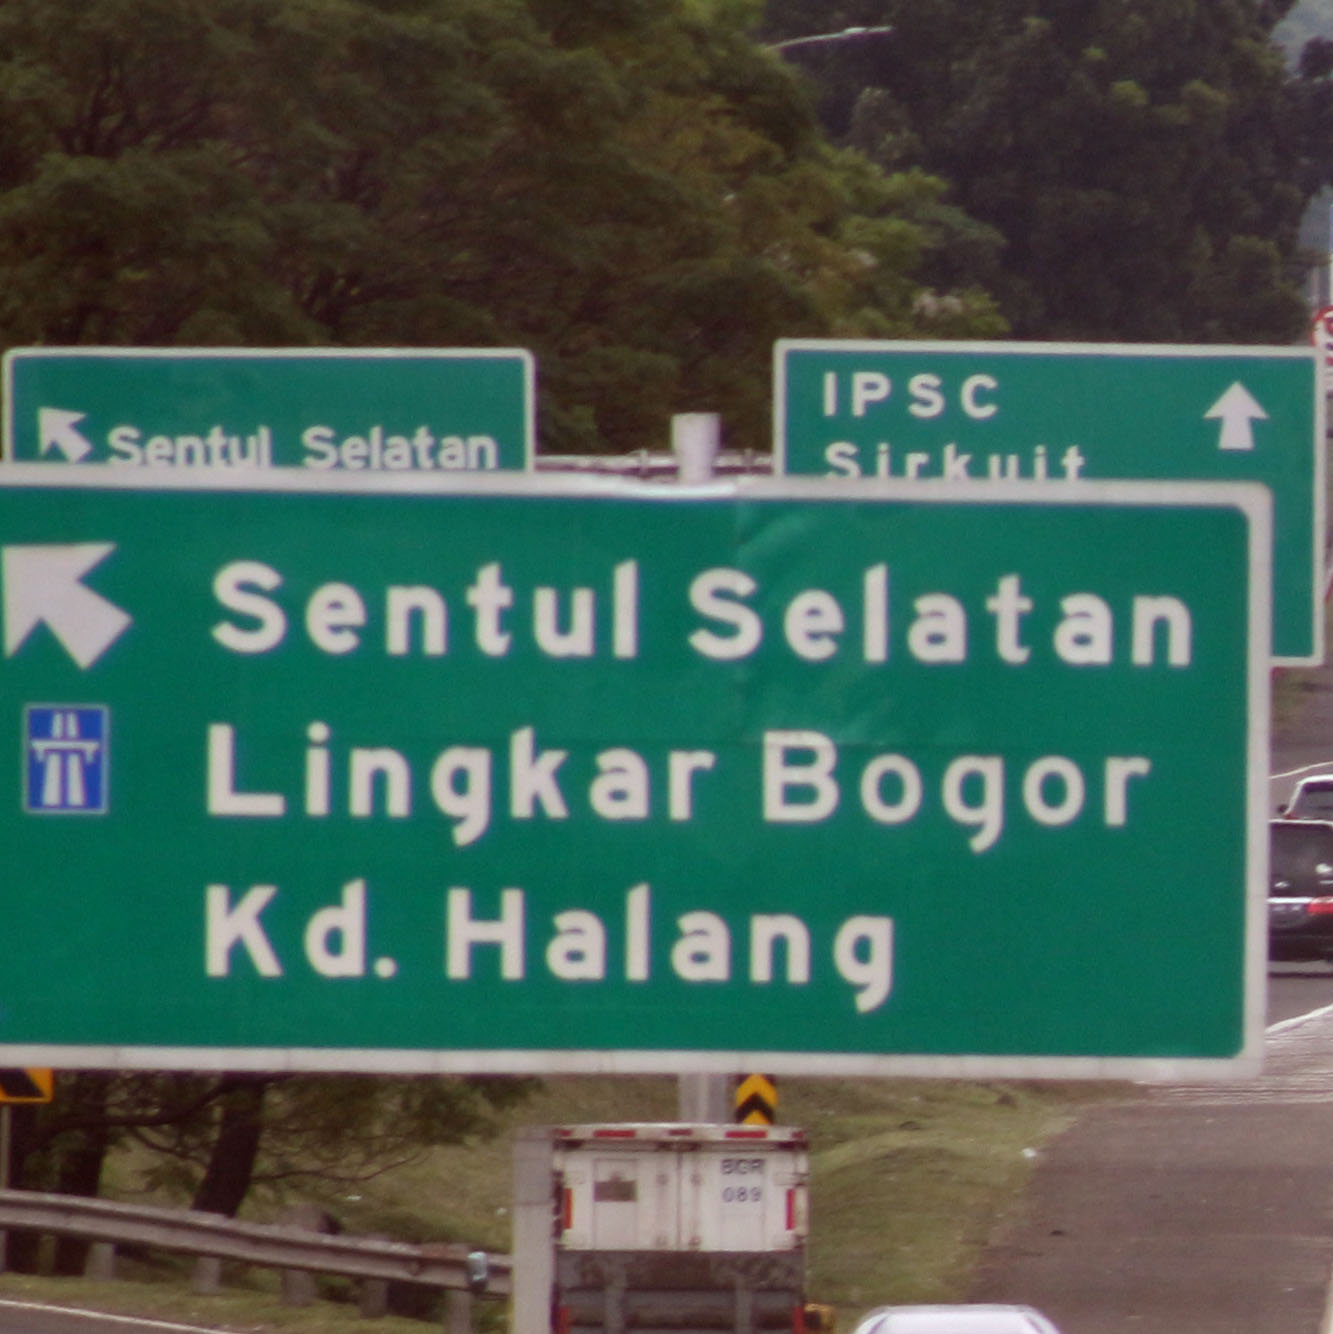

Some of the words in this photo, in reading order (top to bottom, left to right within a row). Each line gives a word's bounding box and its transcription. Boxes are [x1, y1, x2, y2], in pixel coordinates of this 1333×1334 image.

[823, 371, 999, 421] IPSC
[103, 425, 273, 466] Sentul
[302, 425, 499, 469] Selatan
[821, 441, 1085, 480] Sirkuit
[212, 559, 638, 660] Sentul
[688, 563, 1192, 667] Selatan
[206, 722, 716, 846] Lingkar
[763, 730, 1150, 853] Bogor
[206, 879, 397, 979] Kd.
[446, 883, 894, 1013] Halang
[721, 1158, 766, 1175] BGR
